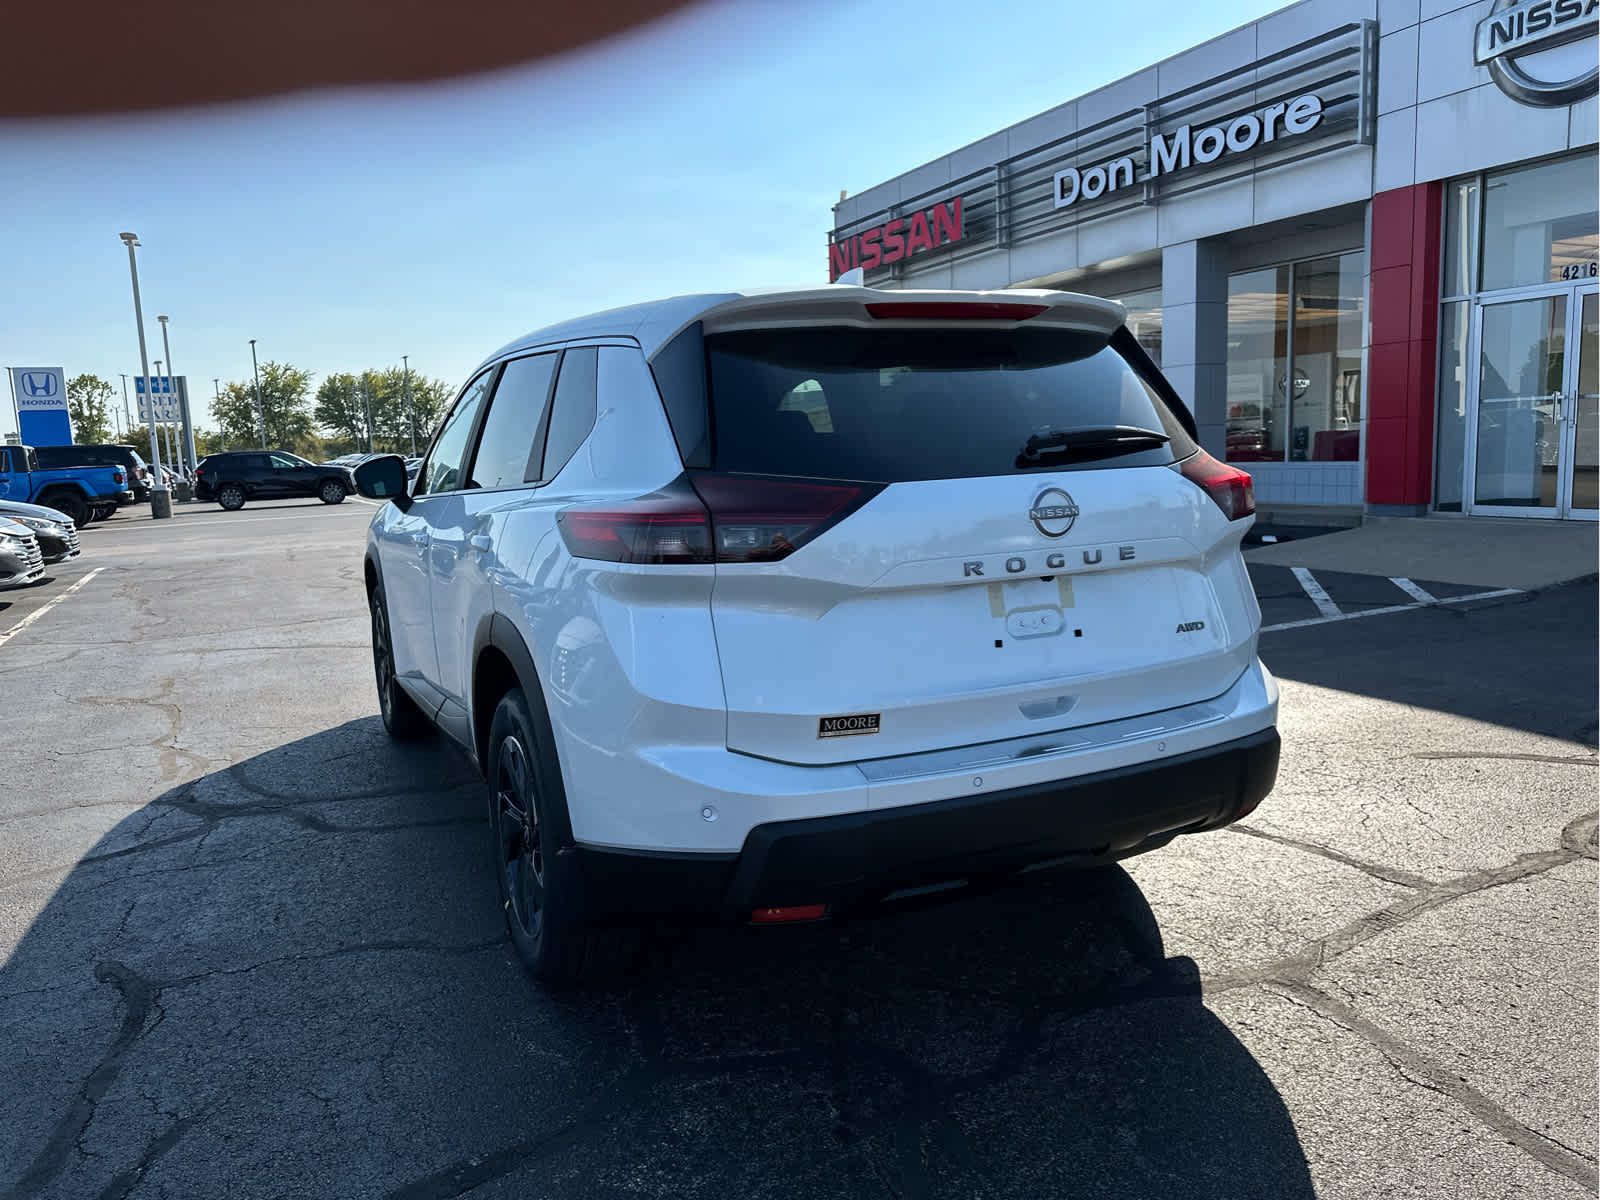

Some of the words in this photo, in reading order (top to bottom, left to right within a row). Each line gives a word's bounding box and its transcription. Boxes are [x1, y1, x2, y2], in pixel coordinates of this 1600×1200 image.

[1054, 157, 1136, 208] Don
[1150, 94, 1324, 178] Moore
[829, 197, 964, 281] NISSAN
[1562, 262, 1597, 281] 4216
[1031, 507, 1079, 518] NISSAN
[963, 545, 1137, 577] ROGUE
[1176, 621, 1205, 633] AWD
[823, 716, 878, 731] MOORE
